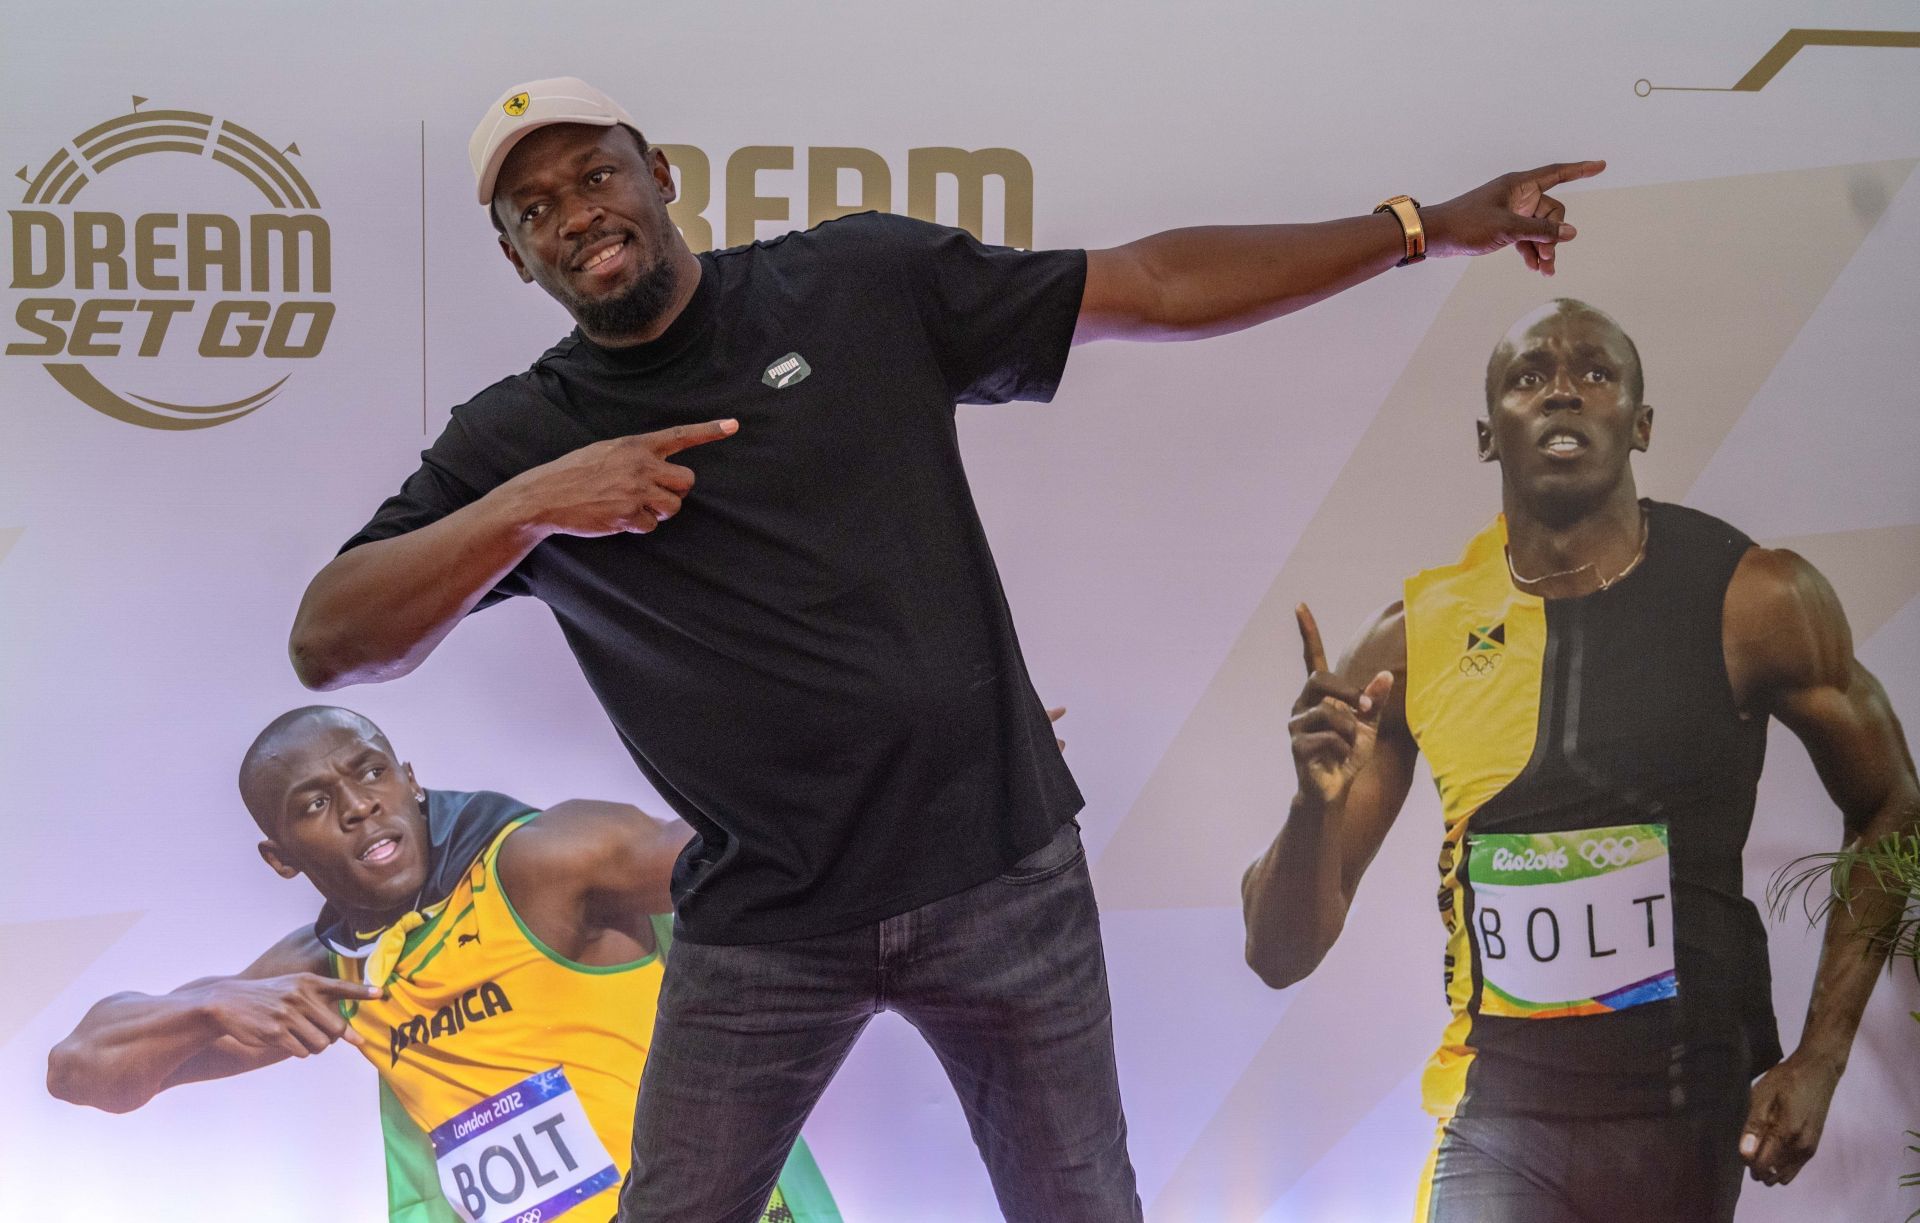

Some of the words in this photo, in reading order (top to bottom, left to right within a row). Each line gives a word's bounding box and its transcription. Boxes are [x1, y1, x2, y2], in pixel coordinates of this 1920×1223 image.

[7, 210, 332, 293] DREAM
[6, 298, 195, 357] SET
[198, 300, 336, 358] GO
[767, 357, 800, 380] PUMA
[1479, 894, 1665, 963] BOLT
[453, 1110, 494, 1140] London
[492, 1091, 524, 1118] 2012
[451, 1112, 579, 1221] BOLT
